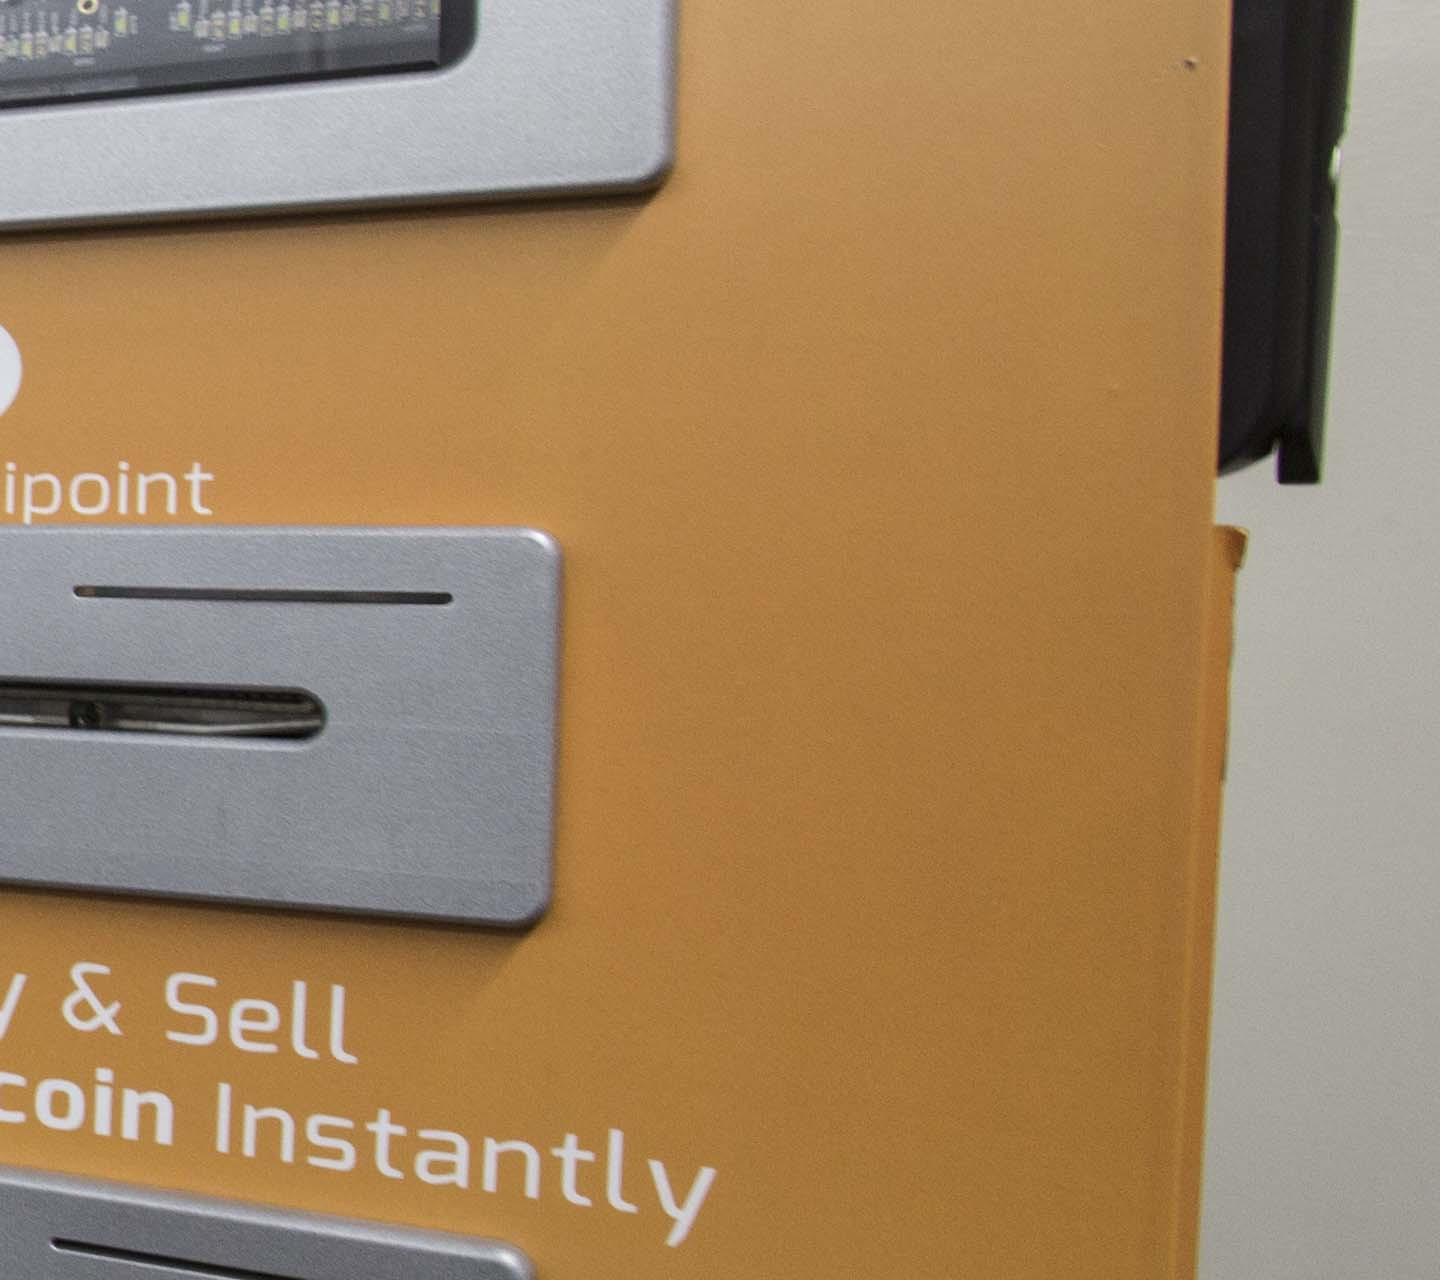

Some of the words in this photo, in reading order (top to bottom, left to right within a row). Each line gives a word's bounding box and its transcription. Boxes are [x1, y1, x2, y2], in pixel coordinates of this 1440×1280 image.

[62, 962, 122, 1035] &
[165, 972, 358, 1064] Sell
[217, 1082, 716, 1247] Instantly
